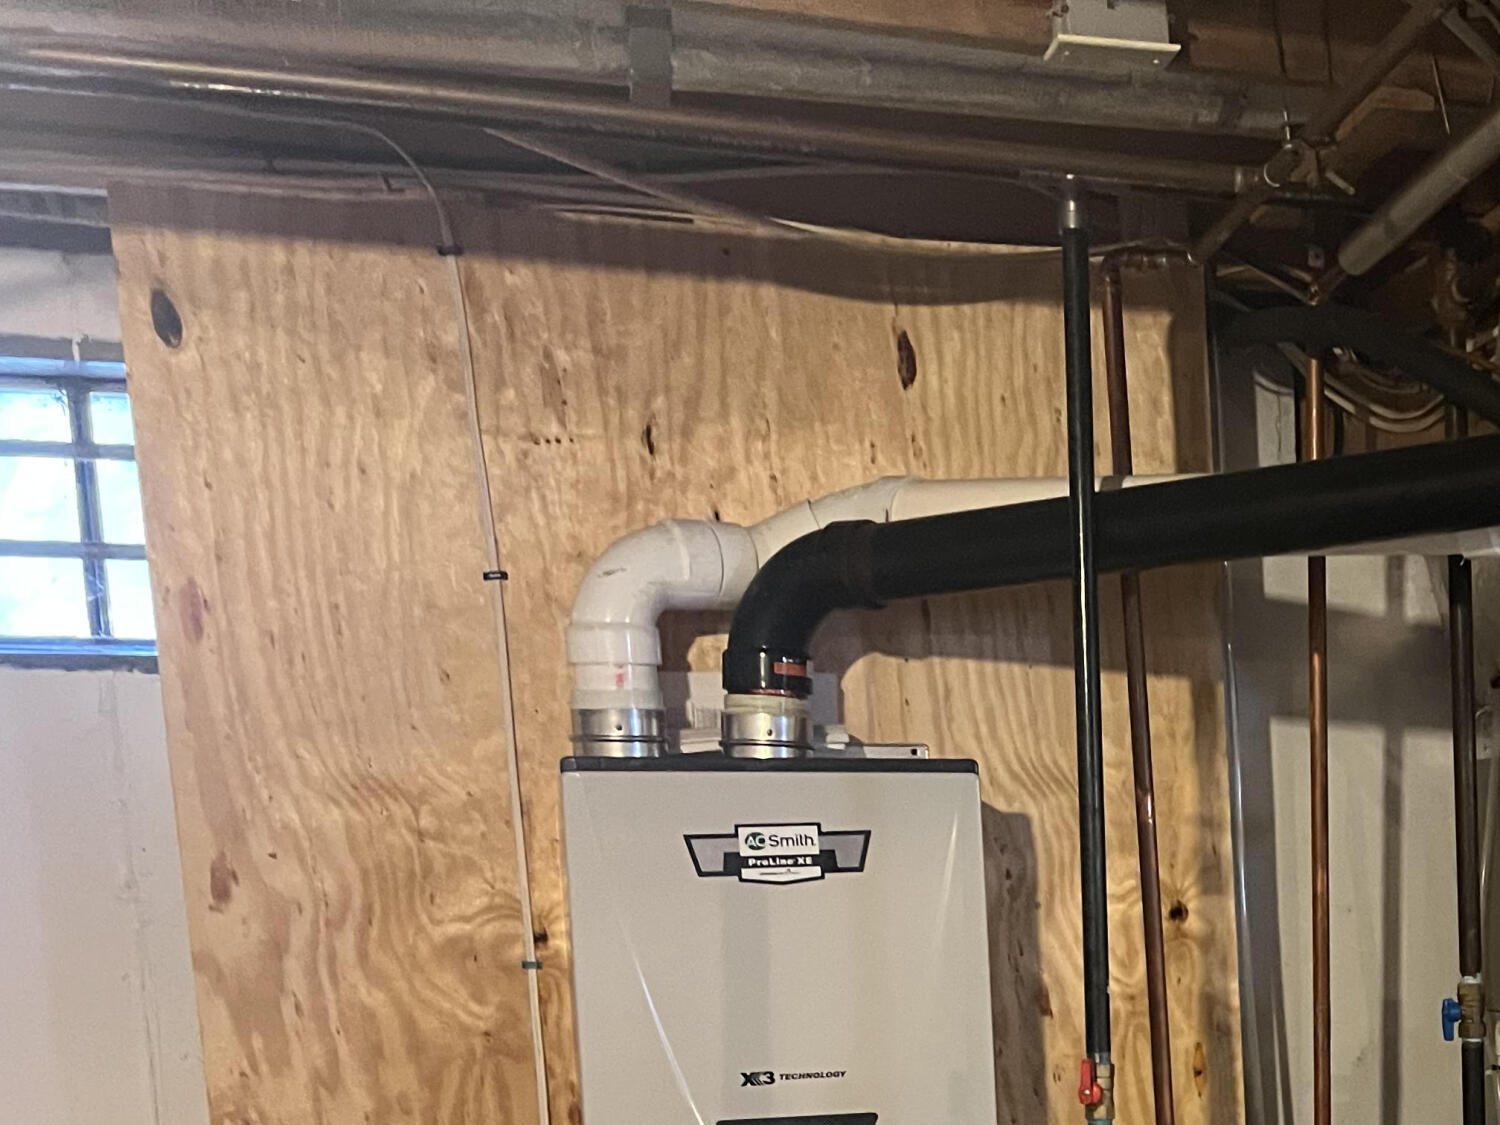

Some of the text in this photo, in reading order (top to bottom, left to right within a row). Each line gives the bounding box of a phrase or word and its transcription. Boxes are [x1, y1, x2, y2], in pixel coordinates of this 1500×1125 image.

[768, 833, 815, 848] Smith
[748, 856, 813, 866] ProLine XE
[779, 1070, 847, 1081] TECHNOLOGY
